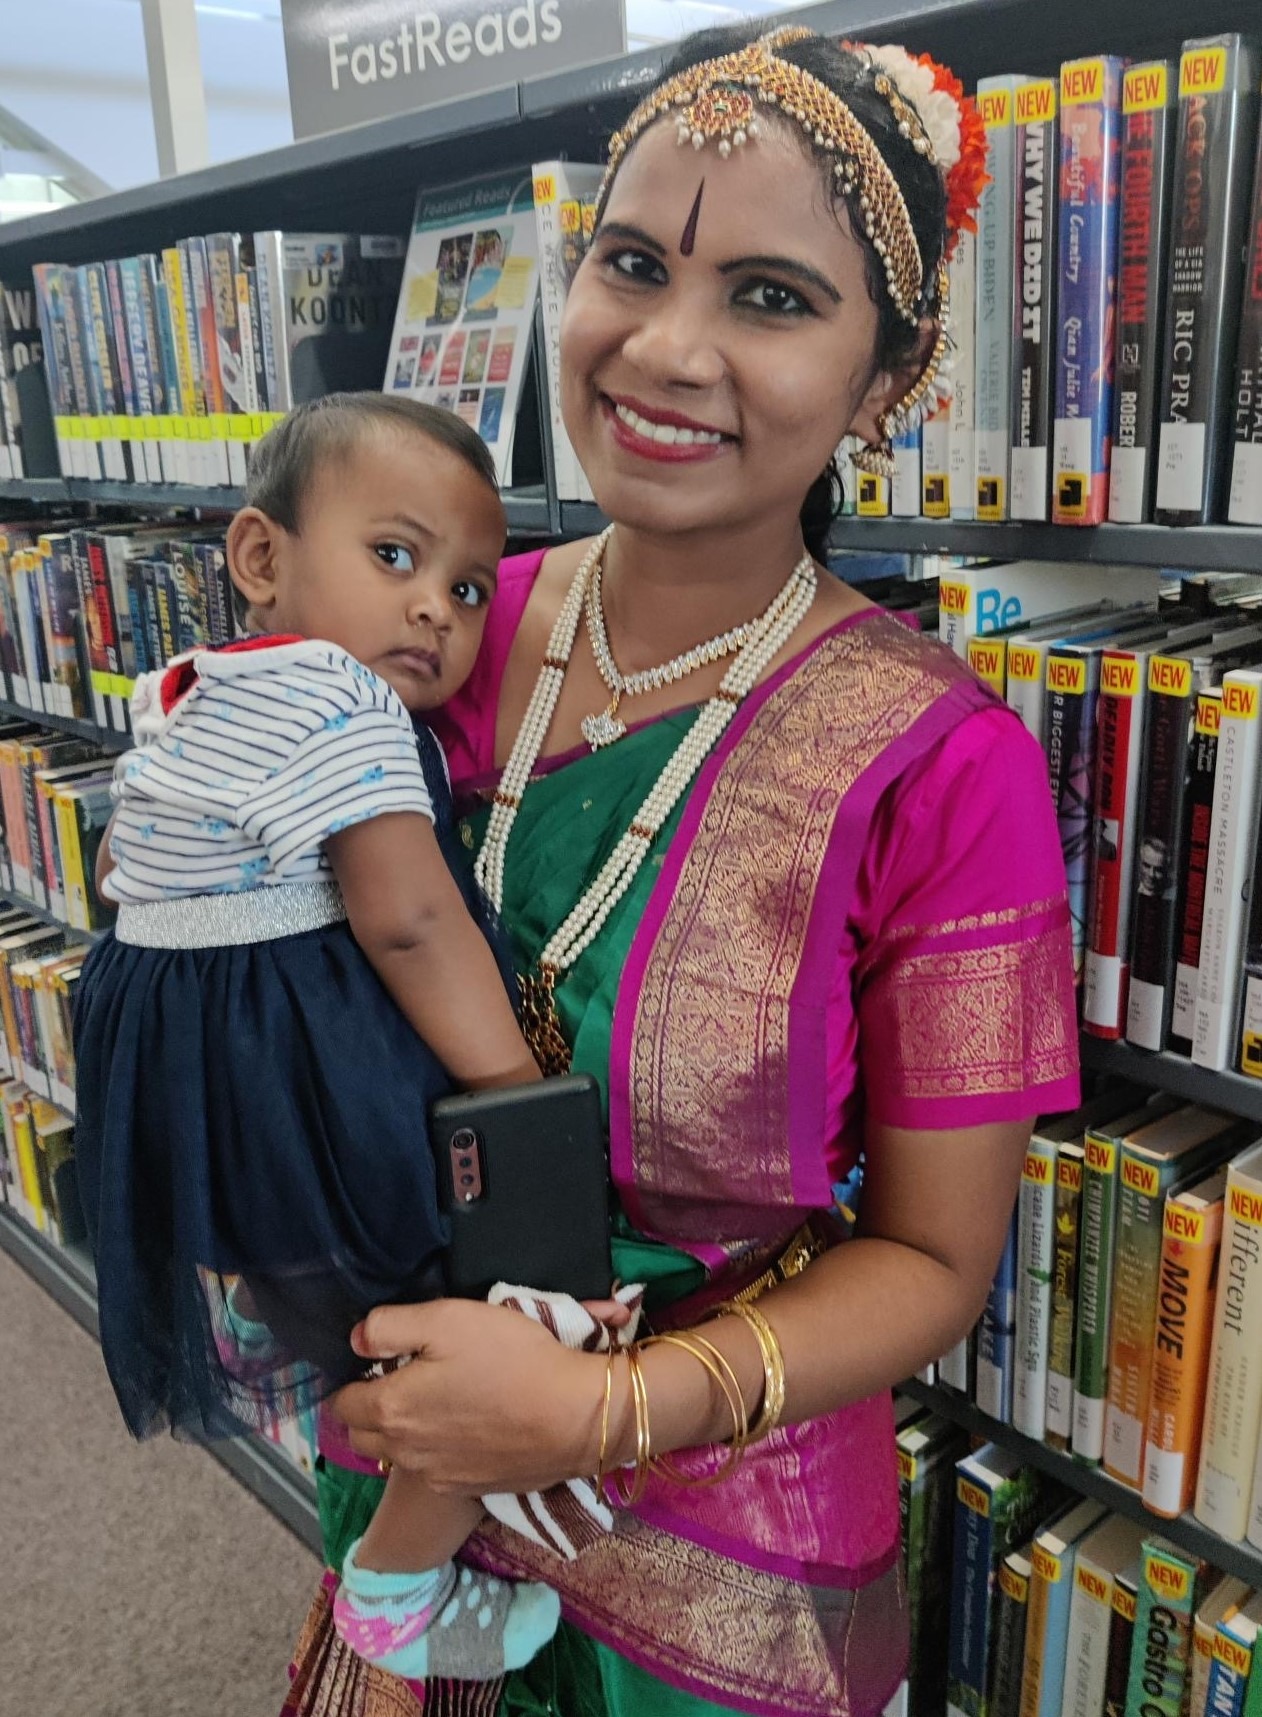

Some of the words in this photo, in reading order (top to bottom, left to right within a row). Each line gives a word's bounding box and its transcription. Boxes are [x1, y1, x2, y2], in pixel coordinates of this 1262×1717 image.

[328, 0, 563, 90] FastReads
[1063, 69, 1097, 98] NEW
[1125, 73, 1160, 106] NEW
[1183, 55, 1219, 87] NEW
[1016, 89, 1051, 120] NEW
[1067, 123, 1088, 207] Beautiful
[1024, 186, 1043, 240] WE
[1123, 150, 1153, 258] FOURTH
[1066, 213, 1084, 284] Country
[1023, 242, 1042, 304] DID
[1122, 265, 1147, 324] MAN
[1022, 305, 1041, 343] IT
[1064, 316, 1081, 356] Qian
[1173, 309, 1195, 362] RIC
[1021, 366, 1031, 398] TIM
[1062, 358, 1080, 398] Julie
[1170, 372, 1190, 424] PRA
[1020, 400, 1031, 447] MILLE
[1119, 391, 1137, 447] ROBER
[1235, 369, 1253, 439] HOLT
[173, 551, 192, 626] LOUISE
[940, 585, 967, 611] NEW
[969, 650, 998, 674] NEW
[1008, 651, 1036, 677] NEW
[1049, 661, 1079, 688] NEW
[1102, 661, 1134, 688] NEW
[1152, 660, 1186, 690] NEW
[1222, 687, 1255, 713] NEW
[1050, 710, 1063, 774] BIGGEST
[1220, 726, 1236, 813] CASTLETON
[1214, 818, 1228, 895] MASSACRE
[1024, 1157, 1047, 1180] EW
[1059, 1163, 1081, 1187] EW
[1124, 1161, 1154, 1191] NEW
[1085, 1180, 1102, 1261] CHIMPANZEE
[1166, 1208, 1200, 1238] NEW
[1231, 1190, 1262, 1222] NEW
[1031, 1222, 1044, 1266] Lizards
[1056, 1247, 1073, 1300] Forest
[1224, 1220, 1259, 1336] ifferent
[1082, 1262, 1099, 1335] WHISPERER
[1157, 1258, 1189, 1360] MOVE
[1028, 1305, 1042, 1346] Plastic
[961, 1484, 986, 1508] NEW
[1078, 1568, 1106, 1599] NEW
[1150, 1562, 1183, 1590] NEW
[1142, 1605, 1177, 1697] Gastro
[1213, 1634, 1246, 1669] NEW
